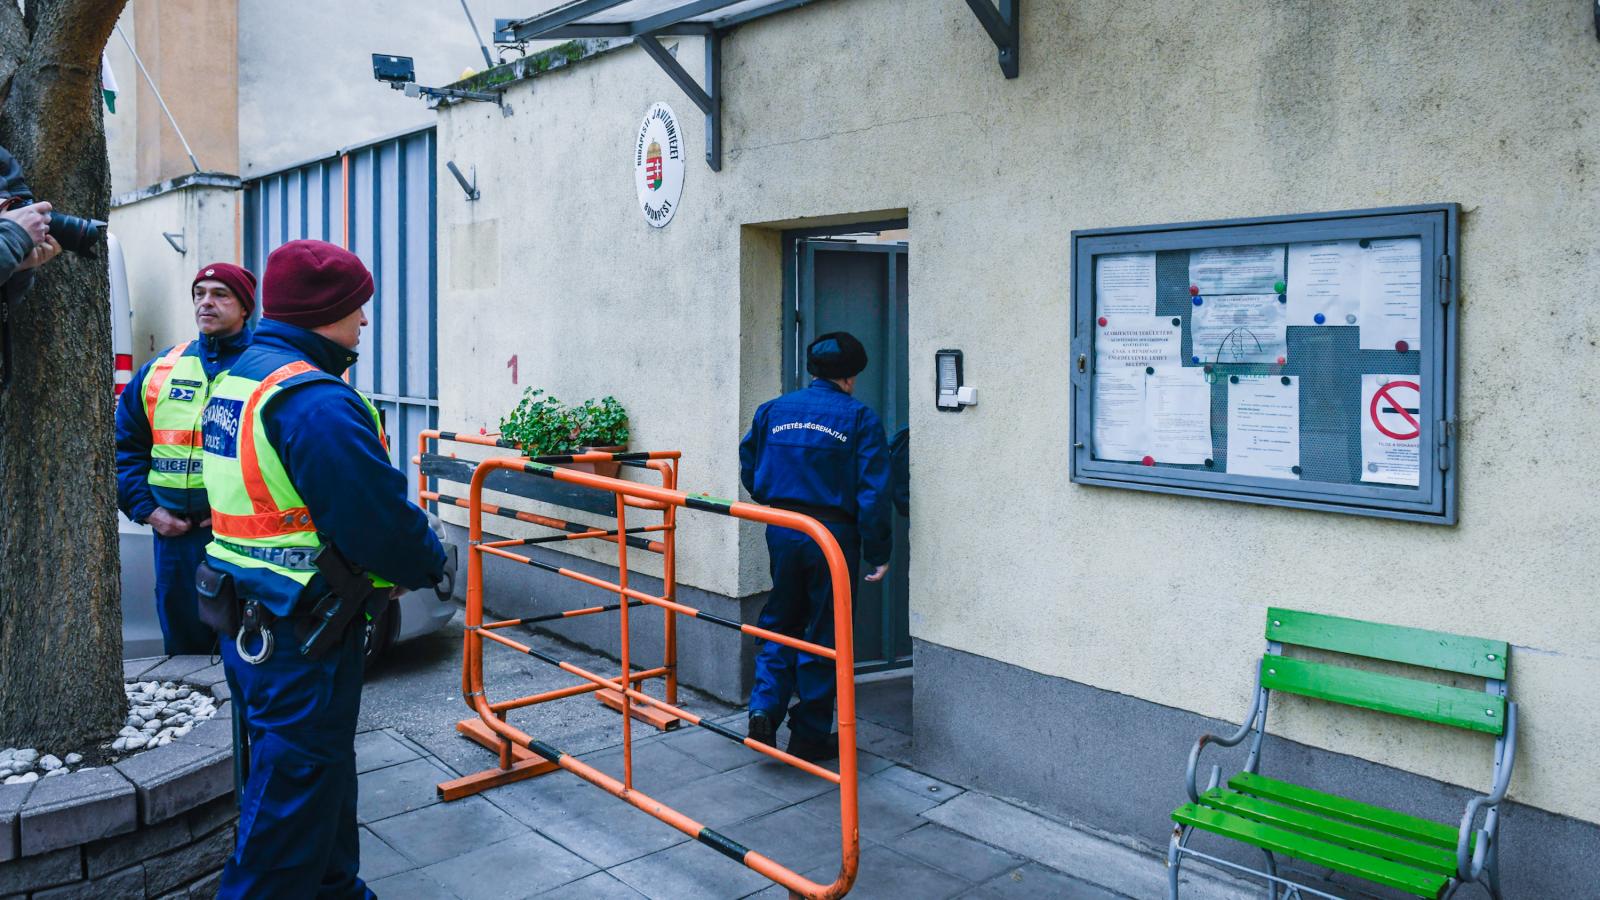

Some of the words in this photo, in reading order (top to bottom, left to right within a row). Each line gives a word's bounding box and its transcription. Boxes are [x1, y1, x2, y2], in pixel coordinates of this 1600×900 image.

[637, 118, 650, 166] BUDAPESTI
[644, 200, 672, 221] BUDAPEST
[507, 354, 518, 384] 1
[205, 433, 221, 450] POLICE
[152, 459, 188, 471] OLICE
